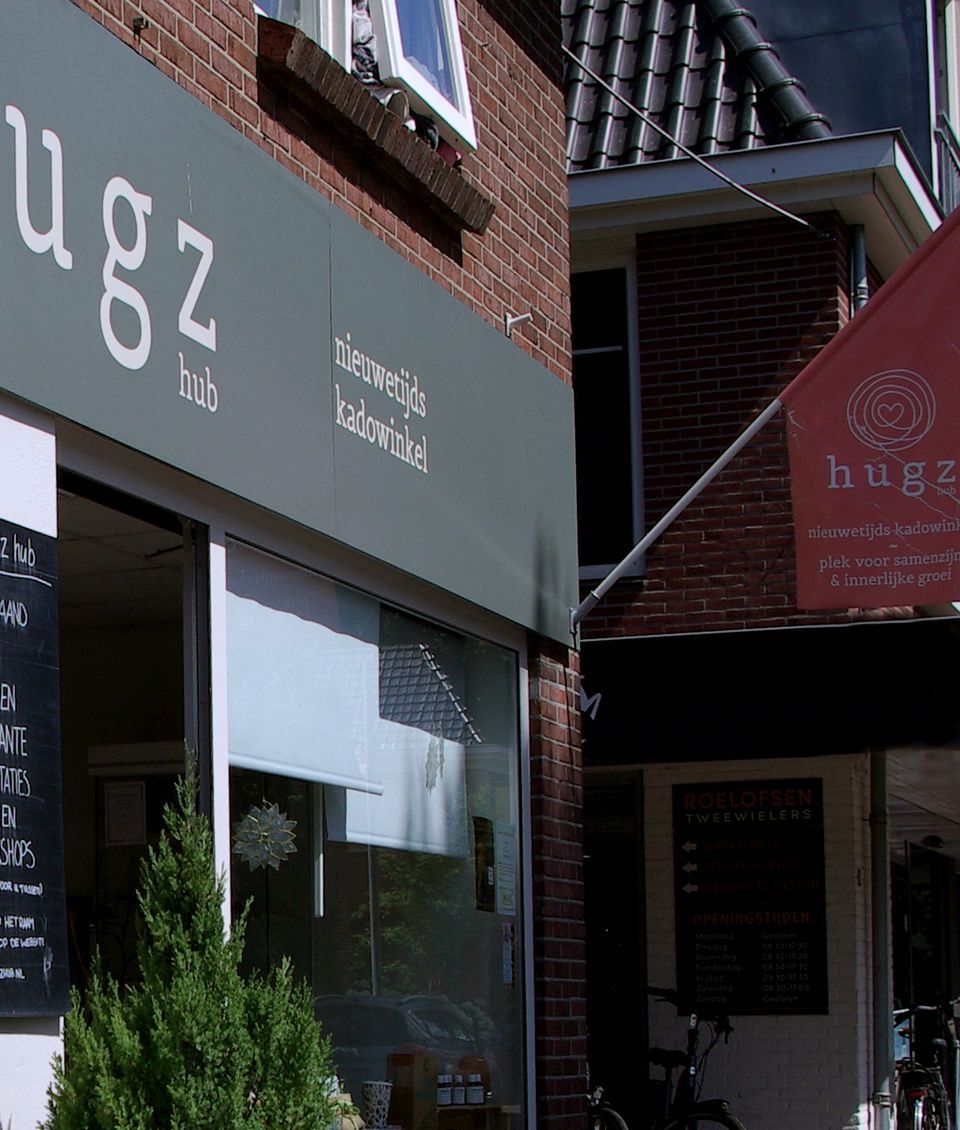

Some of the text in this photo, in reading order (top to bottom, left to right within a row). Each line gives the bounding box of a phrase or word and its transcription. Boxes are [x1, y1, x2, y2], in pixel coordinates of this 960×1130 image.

[177, 351, 219, 413] hub
[335, 332, 426, 420] nieuwetijds
[335, 384, 428, 474] kadowinkel
[827, 455, 956, 497] hugz
[808, 522, 891, 540] nieuwetijds
[13, 534, 36, 567] hub
[819, 554, 850, 573] plek
[856, 556, 890, 568] voor
[830, 567, 952, 589] & innerlijke groei
[0, 683, 16, 712] EN
[684, 788, 813, 810] ROELOFSEN
[1, 803, 16, 829] EN
[685, 809, 812, 825] TWEEWIELERS
[4, 915, 19, 929] HET
[9, 937, 20, 948] DE
